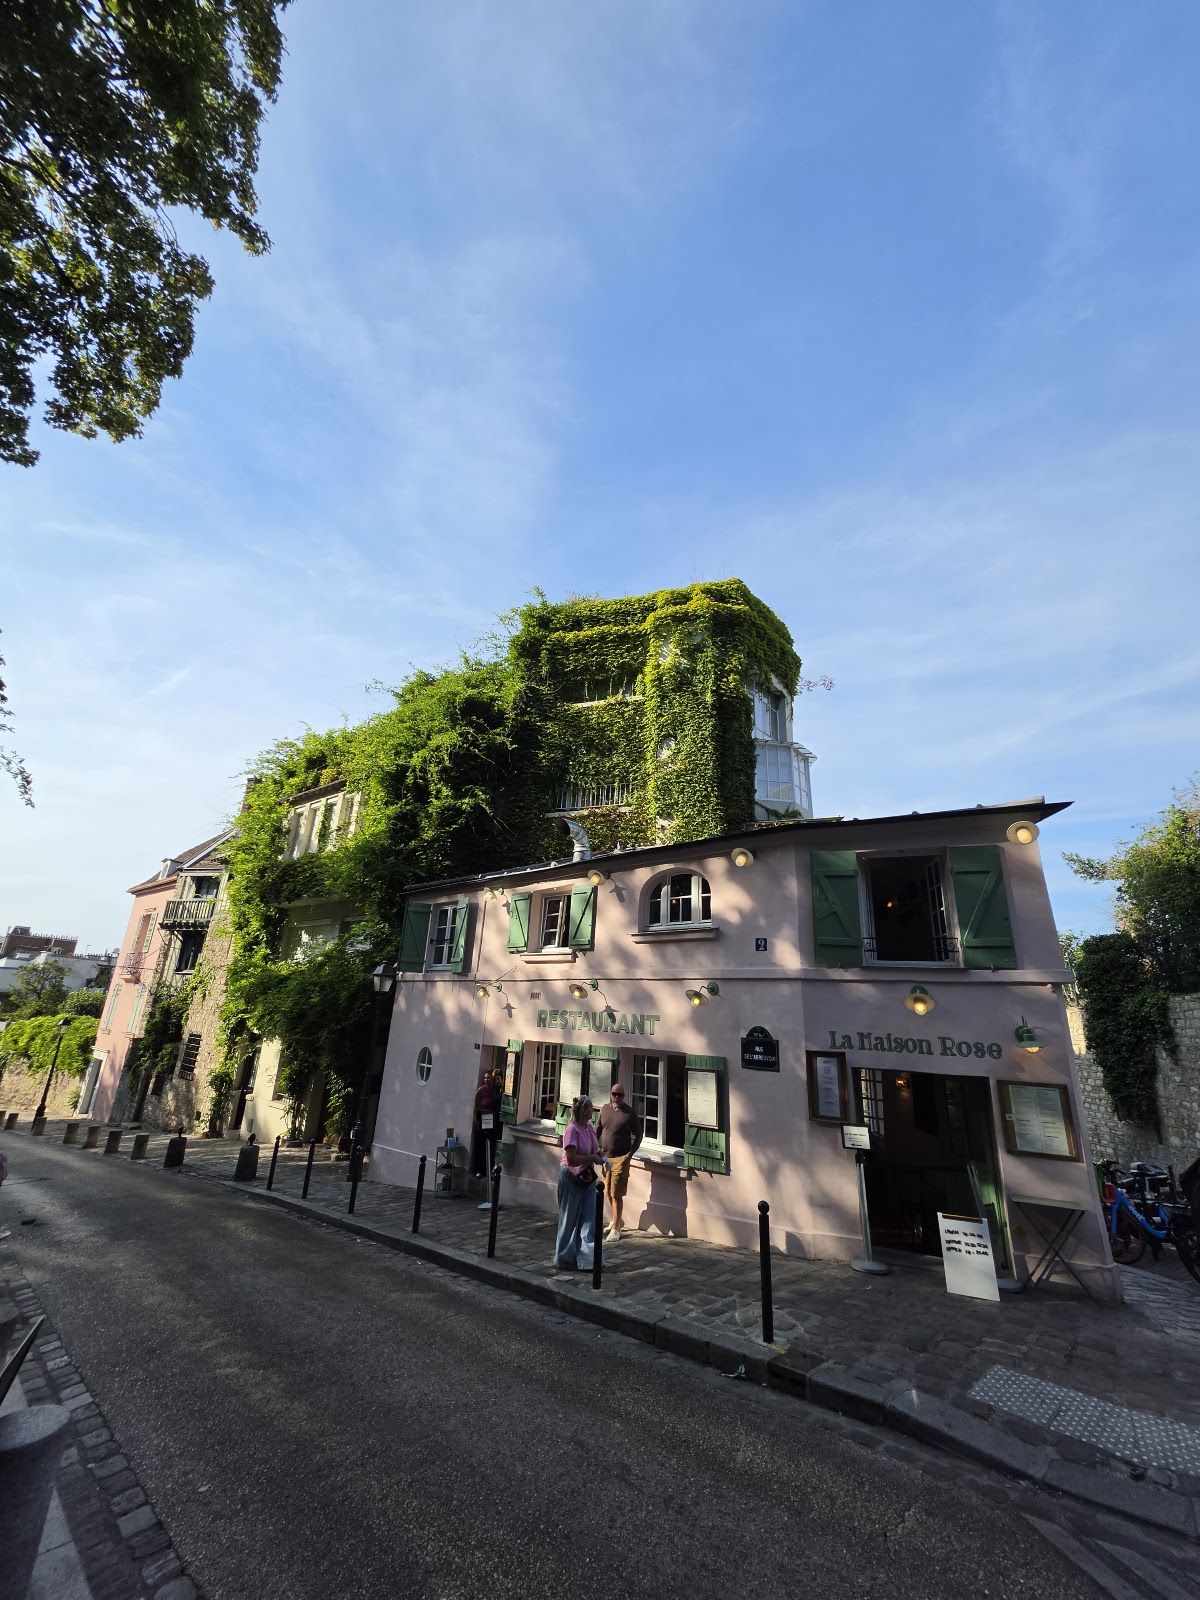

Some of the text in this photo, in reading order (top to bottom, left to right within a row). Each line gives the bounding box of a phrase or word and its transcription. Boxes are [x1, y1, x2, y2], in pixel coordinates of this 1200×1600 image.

[758, 939, 765, 951] 2
[536, 1010, 660, 1035] RESTAURANT
[754, 1045, 764, 1053] RUE
[829, 1030, 1003, 1060] La Maison Rose
